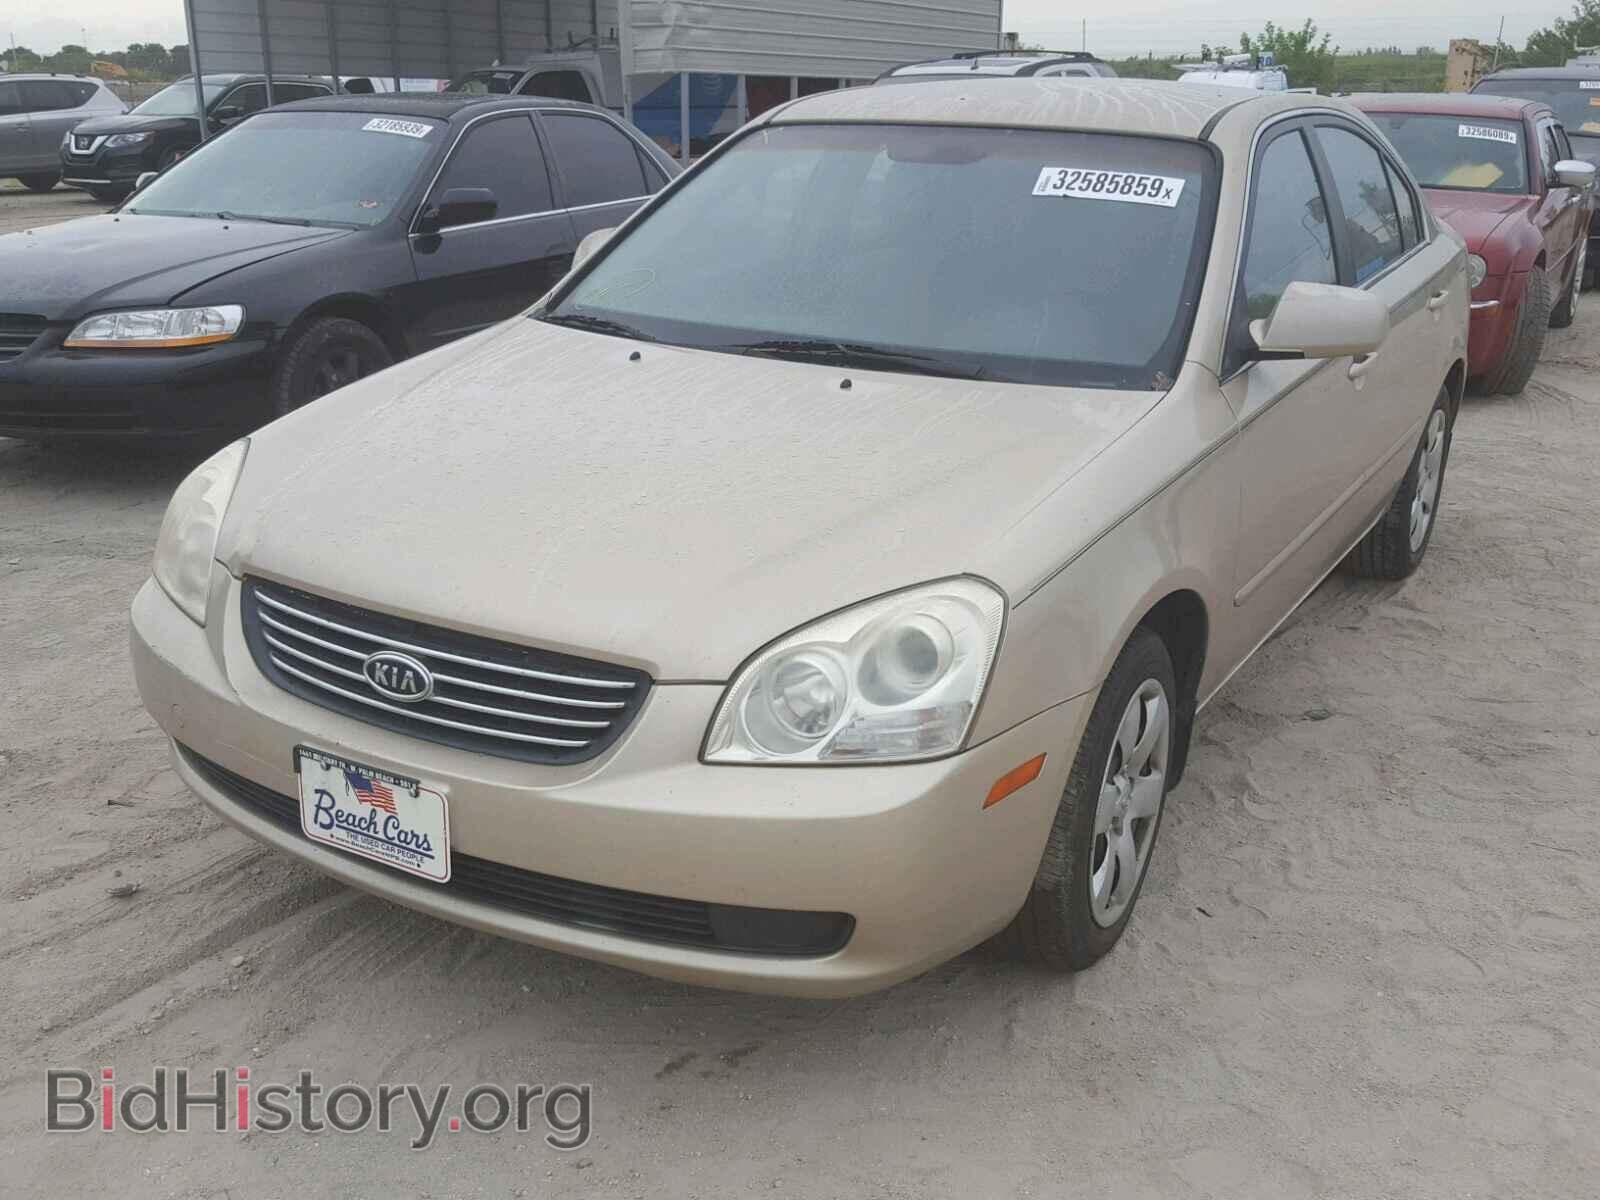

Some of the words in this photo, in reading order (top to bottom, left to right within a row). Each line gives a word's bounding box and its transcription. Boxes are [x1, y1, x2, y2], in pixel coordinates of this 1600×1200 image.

[375, 662, 417, 693] KIA
[314, 788, 379, 834] Beach
[383, 815, 433, 851] Cars
[346, 831, 359, 841] THE
[360, 835, 379, 849] USED
[381, 841, 396, 854] CAR
[397, 845, 425, 864] PEOPLE
